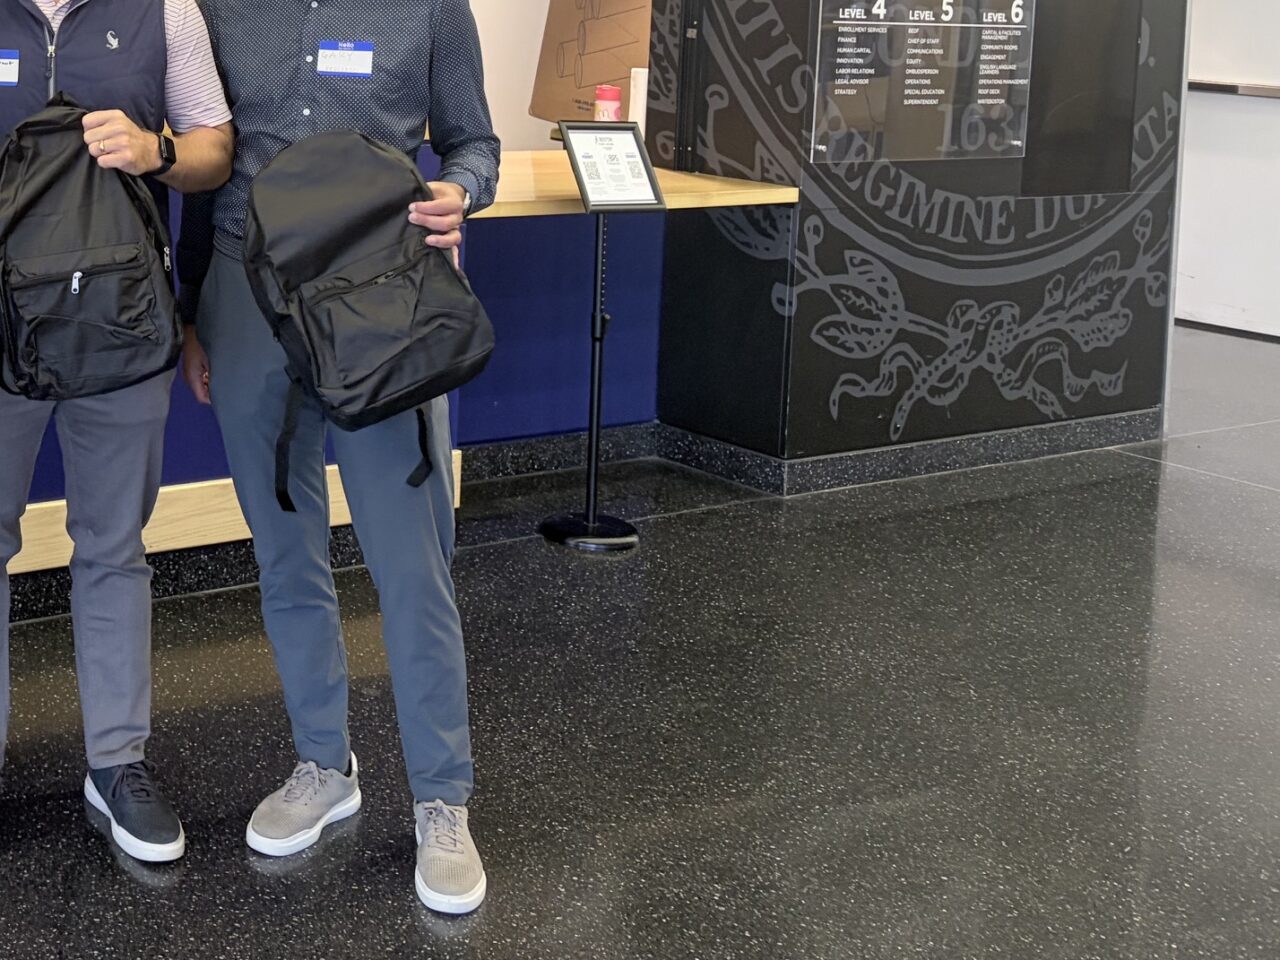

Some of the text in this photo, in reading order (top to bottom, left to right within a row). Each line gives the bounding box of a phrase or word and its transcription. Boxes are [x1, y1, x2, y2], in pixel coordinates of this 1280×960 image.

[839, 8, 867, 19] LEVEL
[909, 10, 935, 20] LEVEL
[983, 12, 1007, 22] LEVEL
